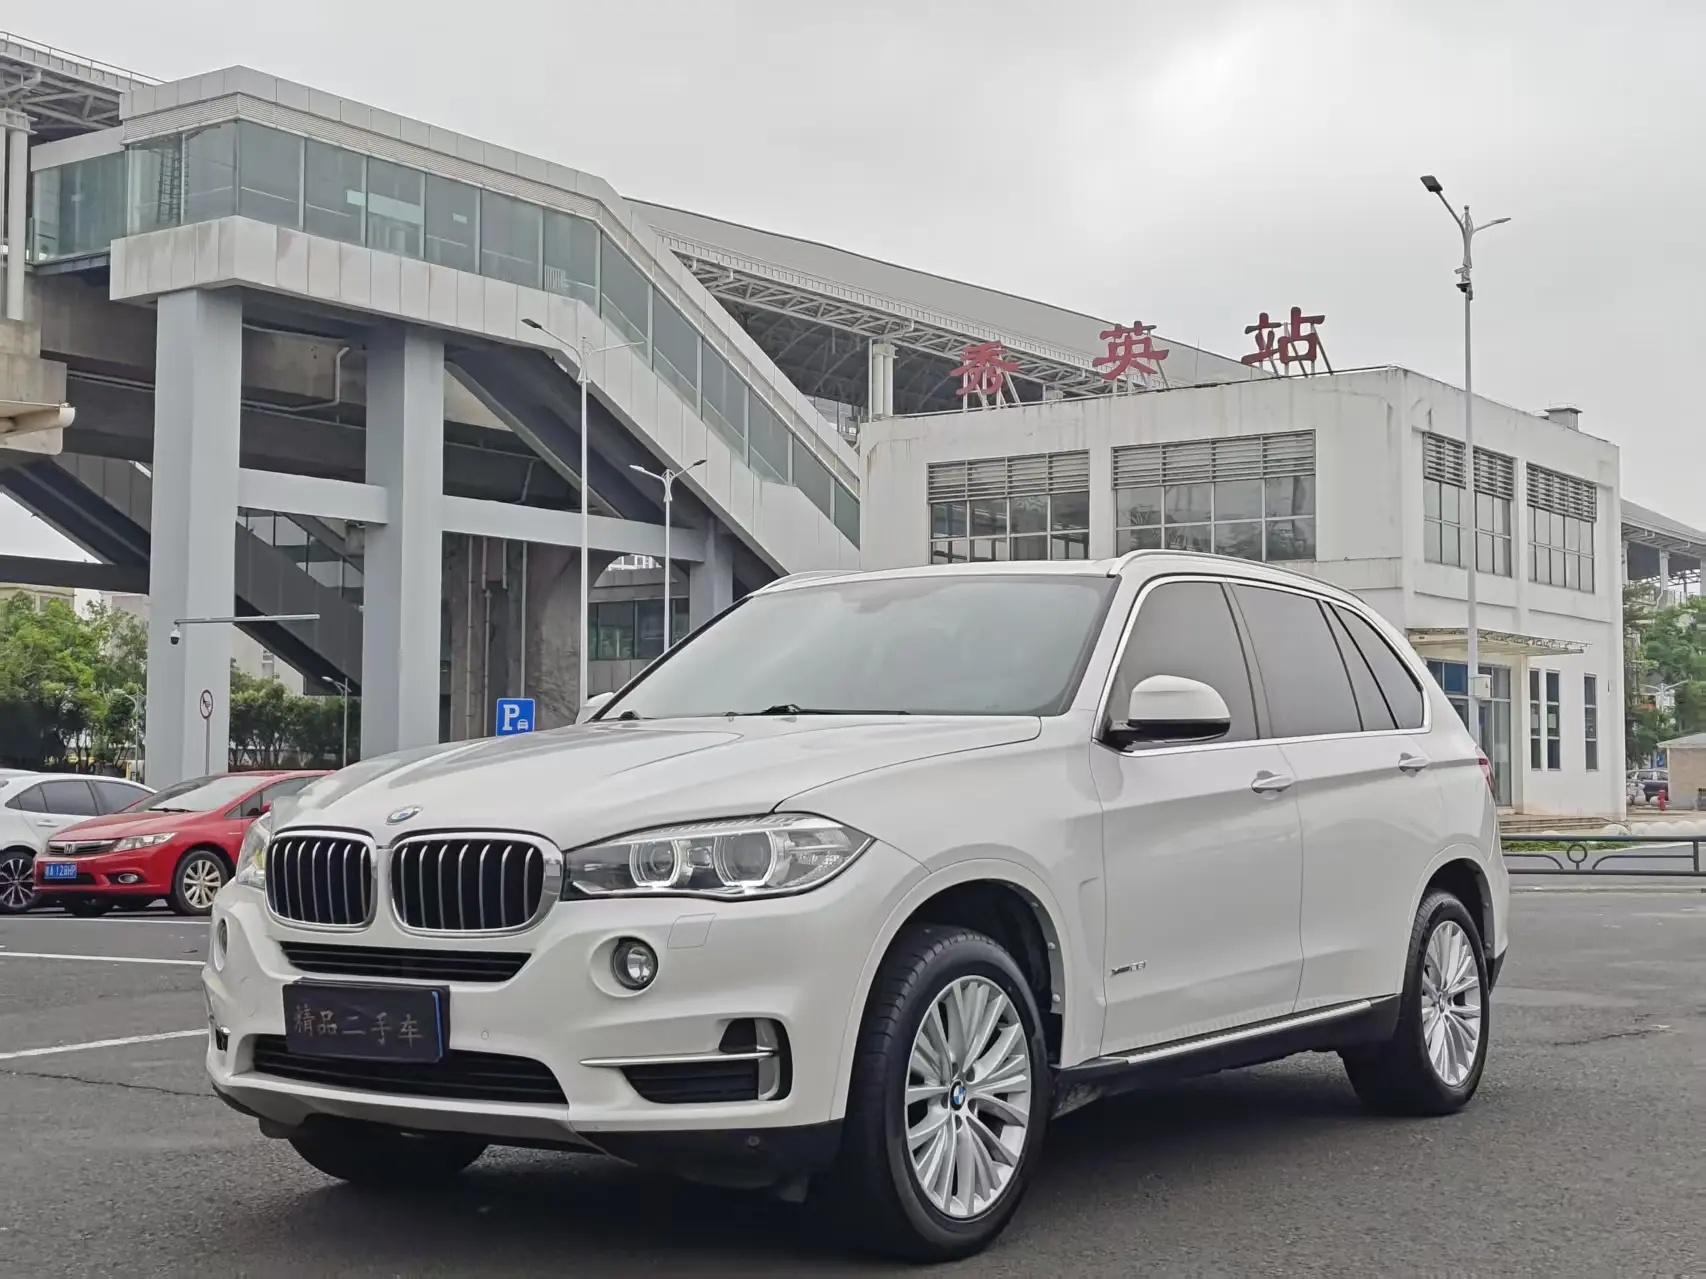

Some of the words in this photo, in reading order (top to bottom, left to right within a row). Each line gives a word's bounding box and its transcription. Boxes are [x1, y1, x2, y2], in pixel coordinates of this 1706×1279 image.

[951, 306, 1325, 395] 秀英站
[502, 704, 520, 730] P
[294, 1003, 423, 1047] 精品二手车
